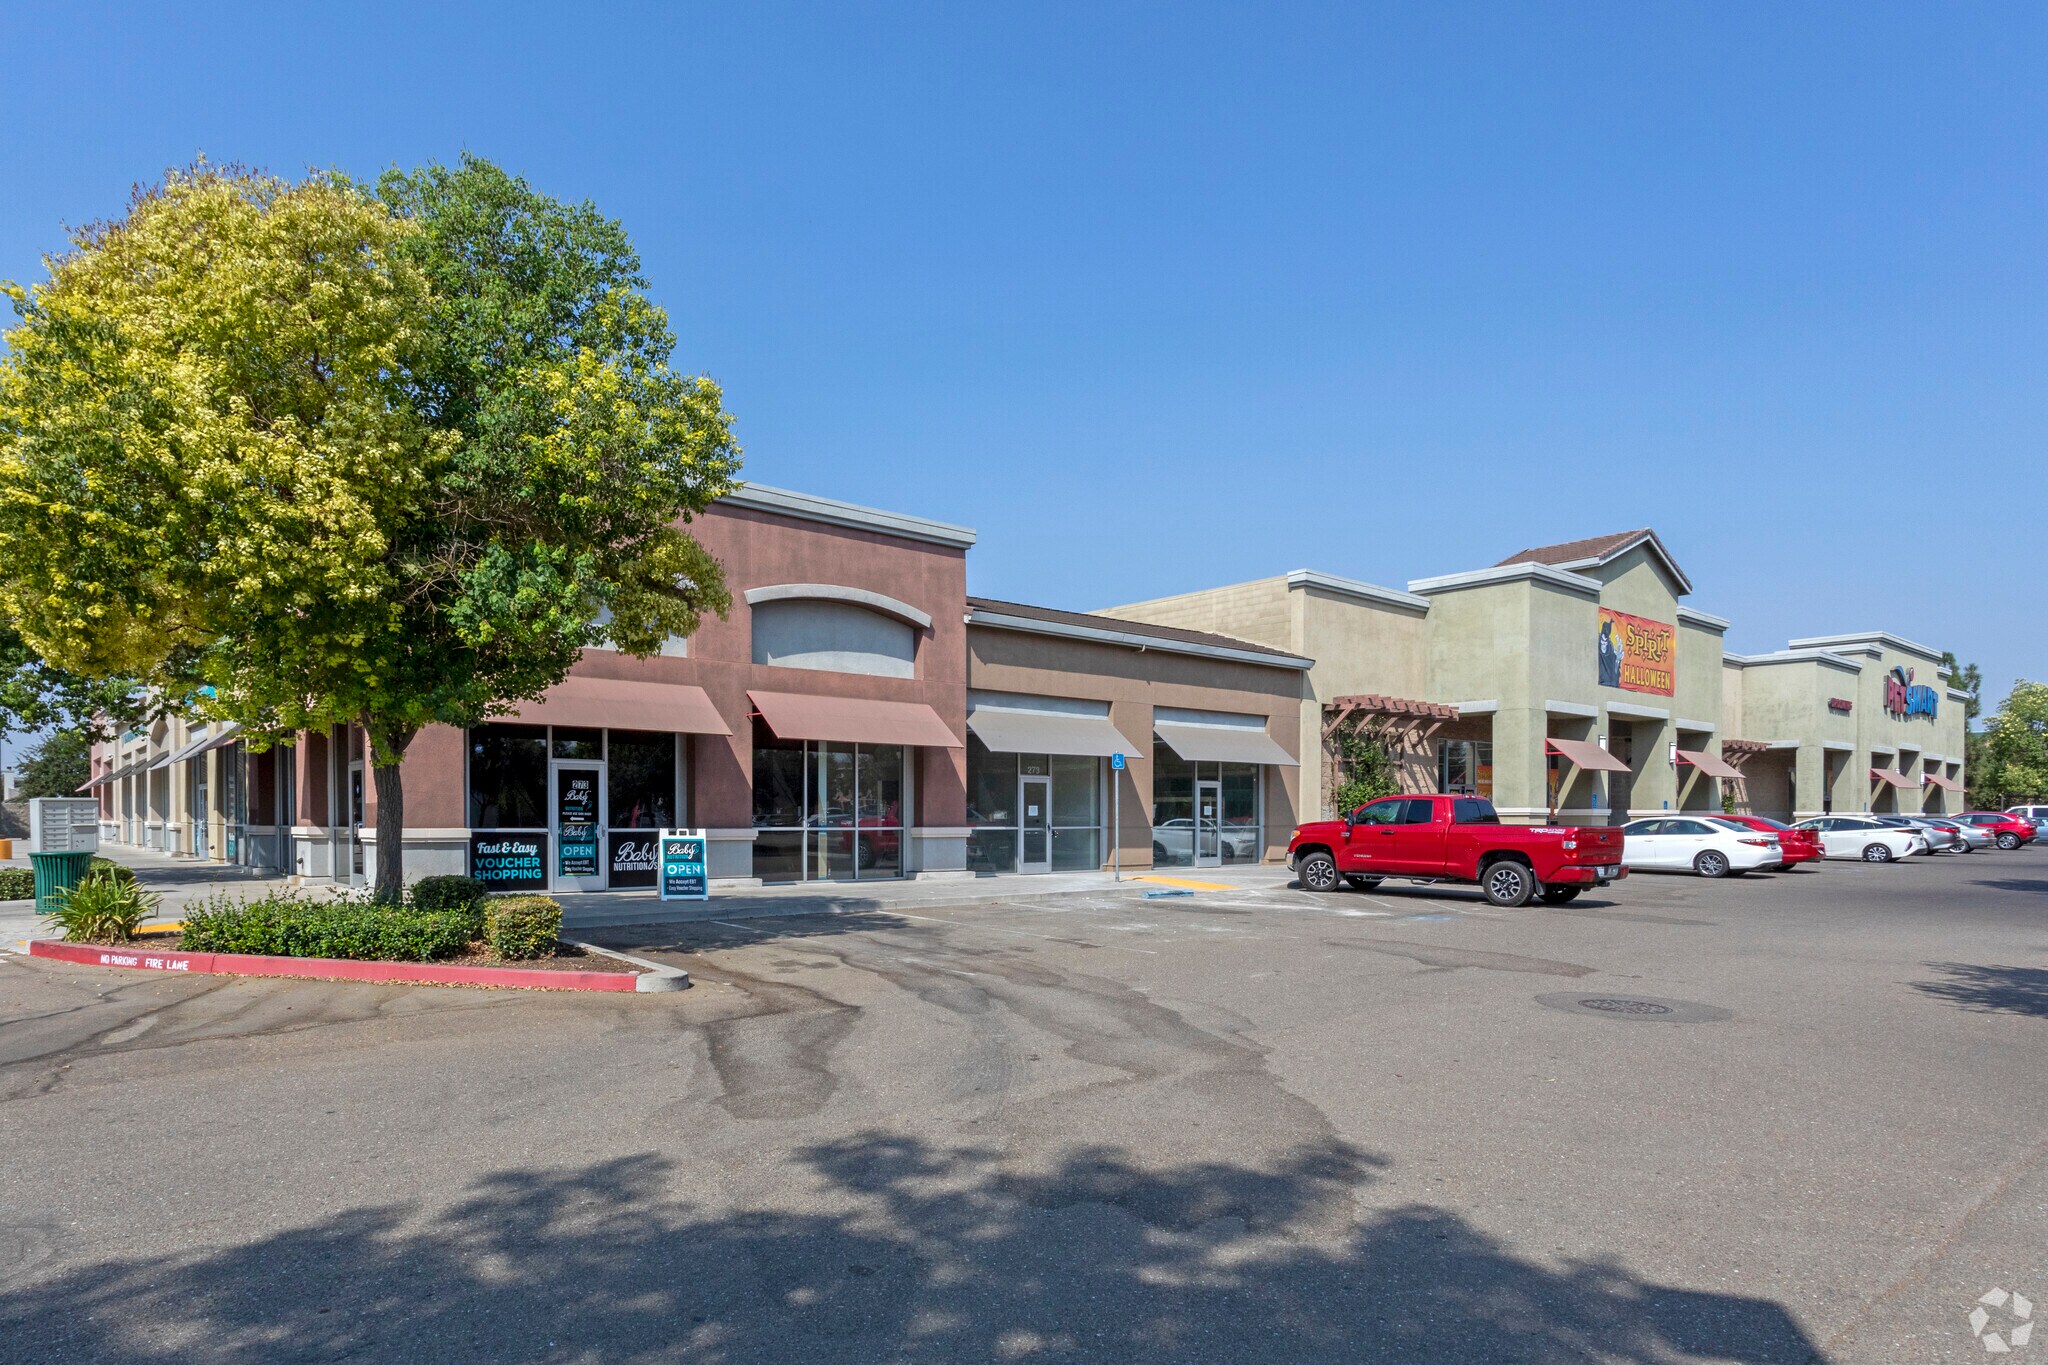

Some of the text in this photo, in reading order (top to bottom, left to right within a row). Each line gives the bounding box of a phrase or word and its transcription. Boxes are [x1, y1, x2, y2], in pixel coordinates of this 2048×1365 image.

[1626, 623, 1671, 662] SPIRIT
[1624, 664, 1671, 690] HALLOWEEN
[564, 790, 590, 805] Baby
[563, 825, 588, 841] Baby
[477, 842, 538, 856] Fast & Easy
[563, 846, 592, 856] OPEN
[615, 841, 658, 870] Baby
[667, 842, 697, 860] Baby
[475, 857, 540, 868] VOUCHER
[613, 861, 648, 871] NUTRITION
[667, 864, 701, 874] OPEN
[474, 869, 542, 880] SHOPPING
[100, 954, 189, 970] NO PARKING FIRE LANE
